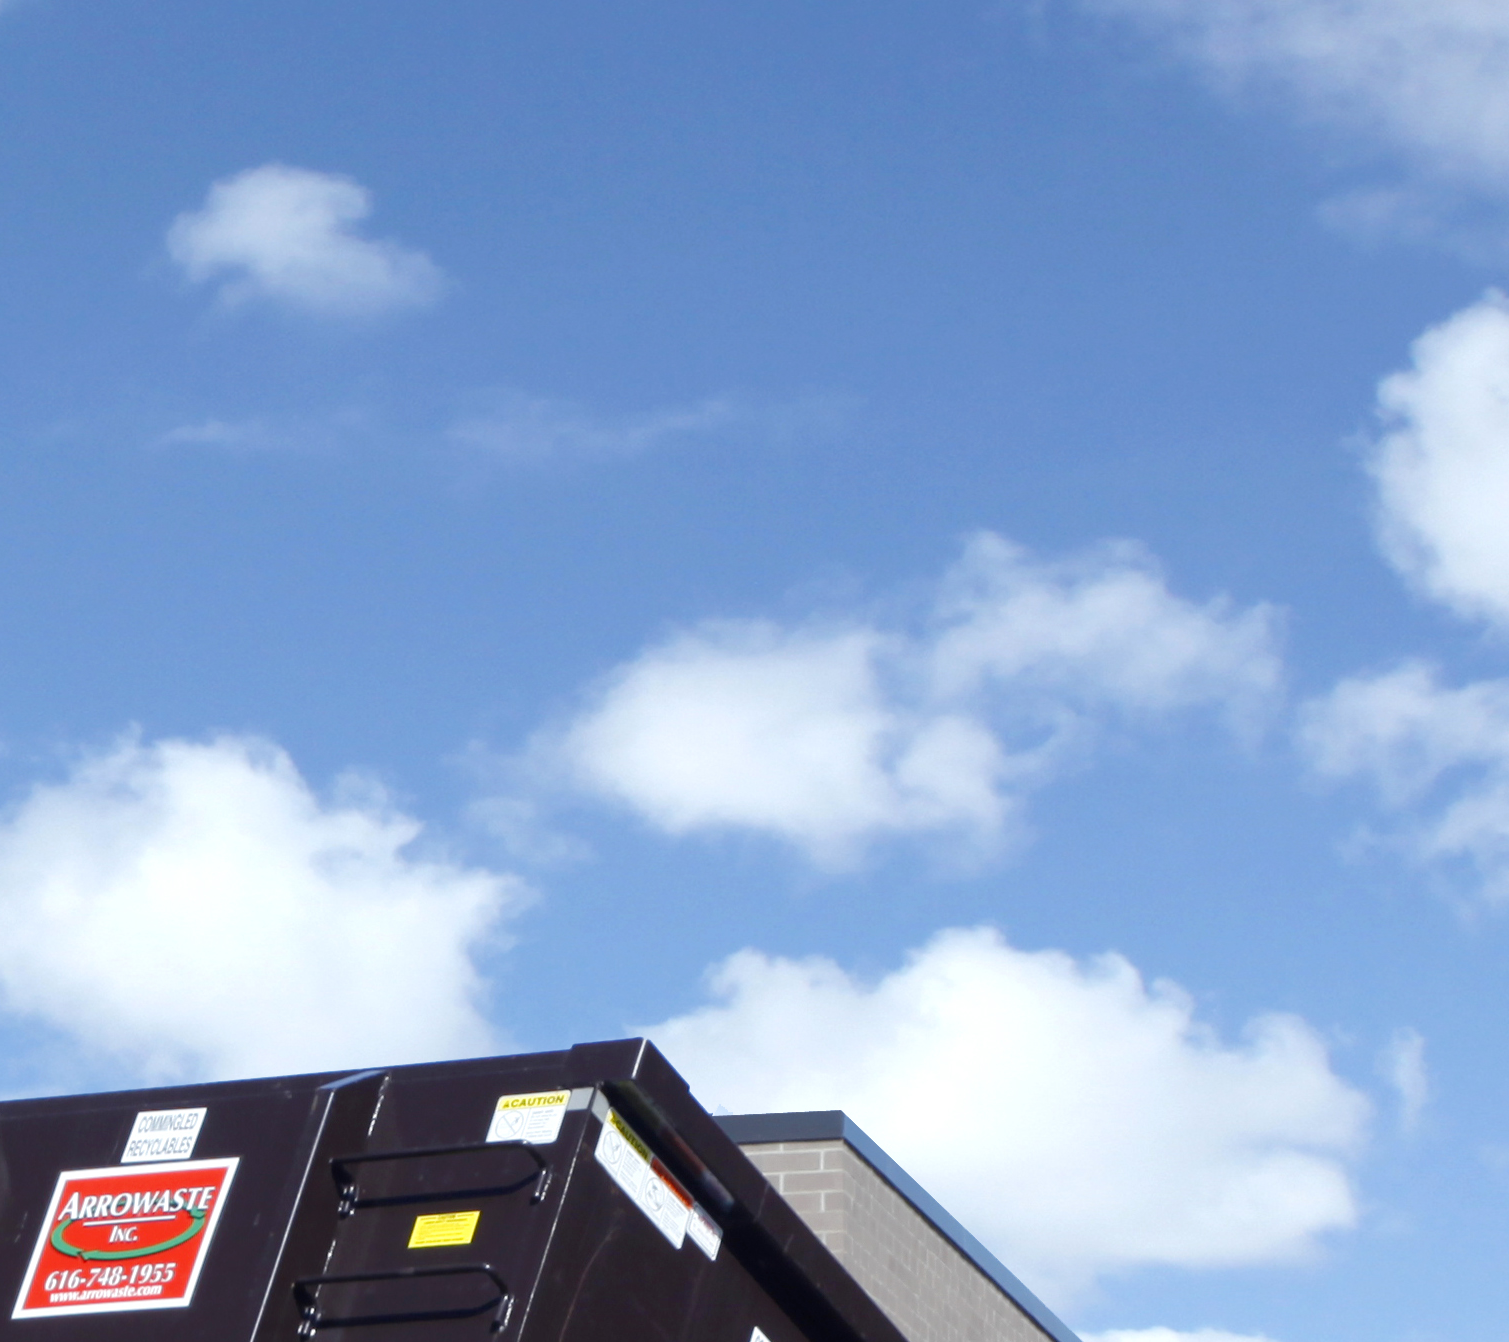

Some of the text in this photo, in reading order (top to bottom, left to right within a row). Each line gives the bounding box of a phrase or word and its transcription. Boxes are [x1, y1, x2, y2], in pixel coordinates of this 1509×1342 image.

[510, 1094, 565, 1108] CAUTION
[137, 1112, 199, 1133] COMMINGLED
[126, 1136, 193, 1157] RECYCLABLES
[58, 1186, 216, 1220] ARROWASTE
[44, 1262, 177, 1291] 616-748-1955
[49, 1284, 163, 1303] www.arrowaste.com
